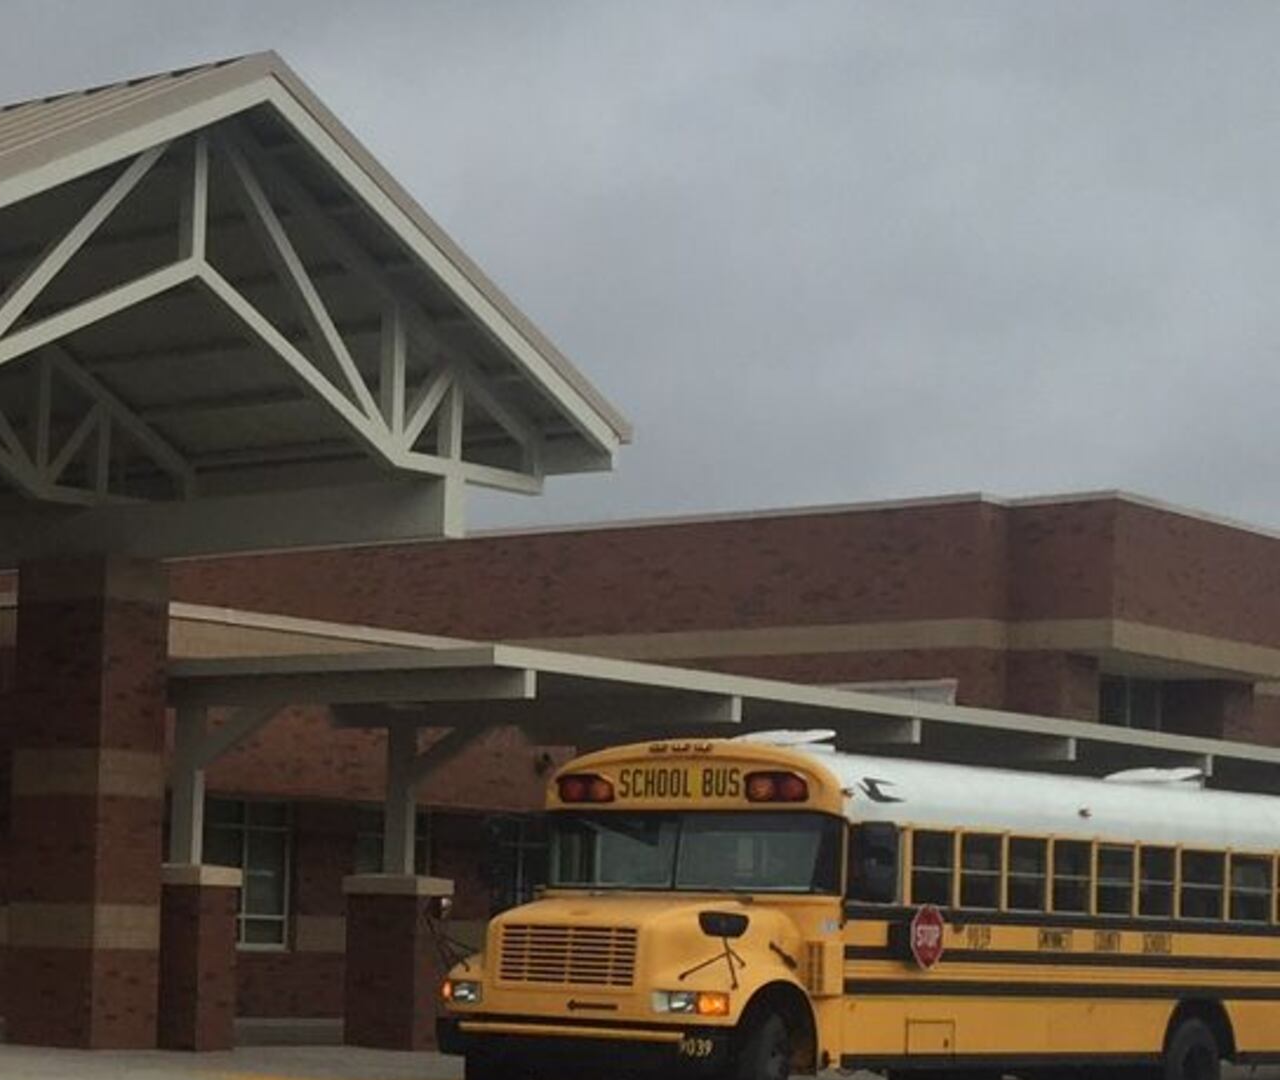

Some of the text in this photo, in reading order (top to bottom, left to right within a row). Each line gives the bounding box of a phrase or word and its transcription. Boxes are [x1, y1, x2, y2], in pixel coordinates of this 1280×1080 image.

[619, 768, 740, 798] SCHOOL BUS
[916, 925, 940, 947] STOP
